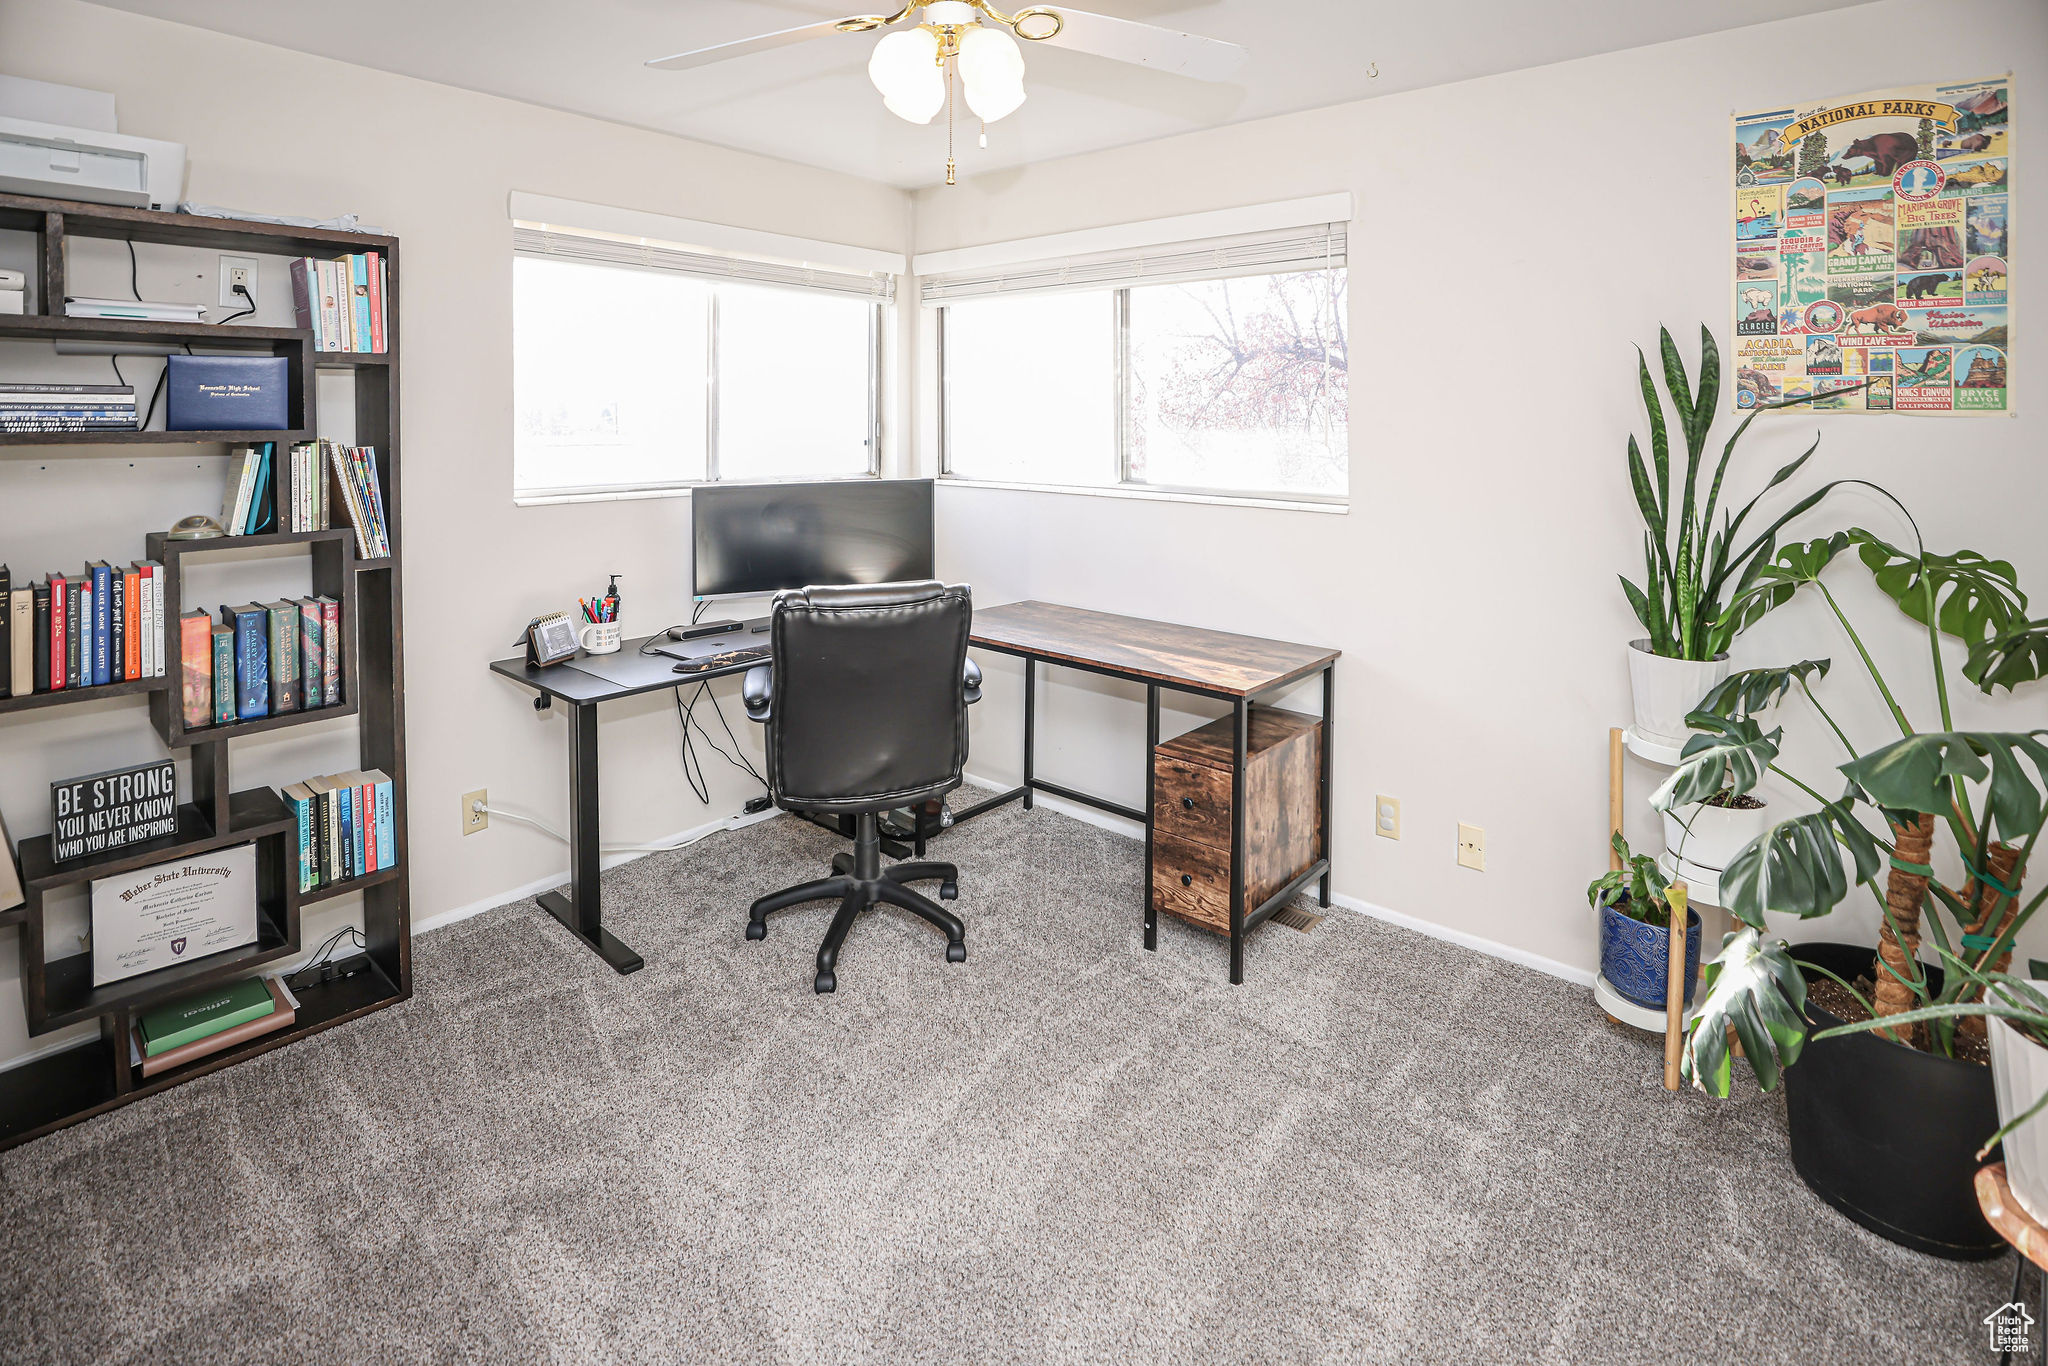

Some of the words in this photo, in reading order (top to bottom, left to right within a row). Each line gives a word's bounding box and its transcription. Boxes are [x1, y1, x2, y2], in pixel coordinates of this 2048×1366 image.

[1798, 104, 1875, 133] NATIONAL
[1882, 102, 1936, 116] PARKS
[1895, 161, 1944, 183] YELLOWSTONE
[1895, 185, 1927, 201] NATIONAL
[1898, 201, 1937, 217] MARIPOSA
[1937, 199, 1963, 212] GROVE
[1907, 214, 1926, 223] BIG
[1927, 211, 1957, 221] TREES
[1780, 236, 1814, 245] SEQUOIA
[1828, 257, 1857, 267] GRAND
[1858, 254, 1895, 266] CANYON
[1898, 300, 1917, 308] GREAT
[1740, 321, 1776, 331] GLACIER
[1744, 338, 1794, 350] ACADIA
[1840, 336, 1862, 347] WIND
[1863, 335, 1887, 346] CAVE
[1738, 349, 1779, 357] NATIONAL
[1780, 348, 1803, 356] PARK
[1753, 362, 1786, 371] MAINE
[228, 384, 242, 392] High
[243, 384, 261, 392] School
[1897, 388, 1919, 397] KINGS
[1921, 387, 1951, 397] CANYON
[1961, 389, 2000, 397] BRYCE
[68, 589, 77, 615] Keeping
[68, 617, 77, 633] Lucy
[155, 608, 163, 631] EDGE
[58, 784, 84, 817] BE
[93, 766, 173, 808] STRONG
[57, 815, 84, 840] YOU
[88, 805, 131, 832] NEVER
[134, 795, 174, 822] KNOW
[310, 807, 314, 815] TO
[342, 808, 351, 823] LOVE
[58, 838, 84, 859] WHO
[86, 833, 105, 853] YOU
[107, 828, 126, 847] ARE
[128, 817, 174, 842] INSPIRING
[309, 836, 318, 868] Mockingbird
[119, 881, 153, 902] Weber
[153, 870, 180, 888] State
[181, 866, 232, 878] University
[155, 912, 177, 921] Bachelor
[183, 906, 200, 914] Science
